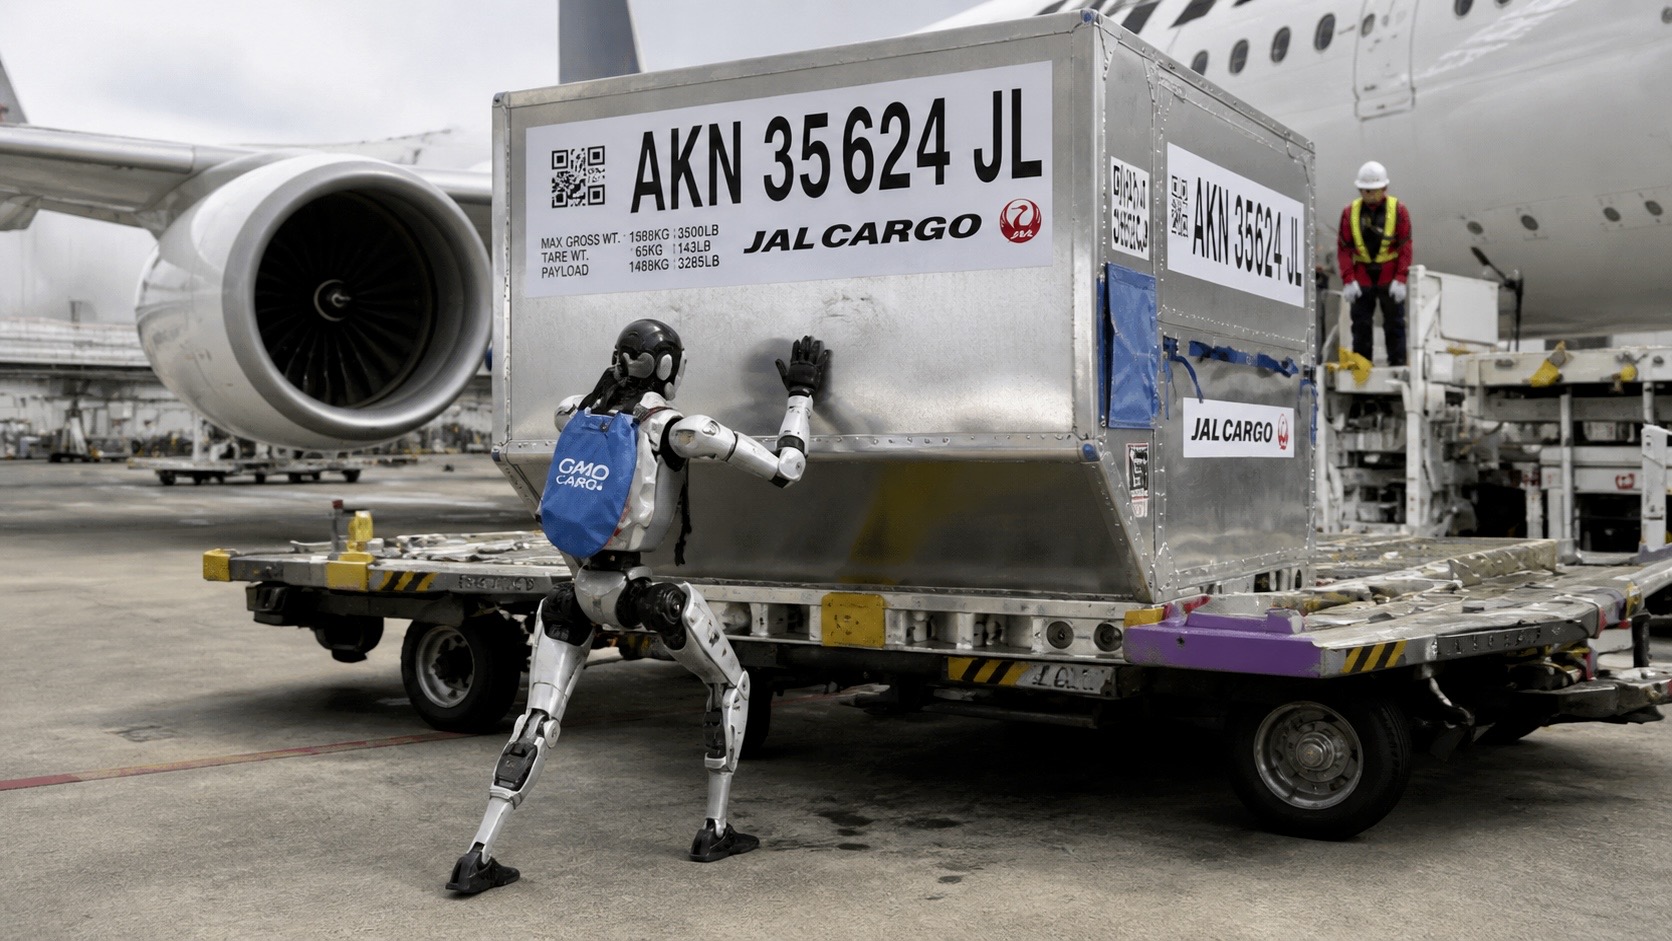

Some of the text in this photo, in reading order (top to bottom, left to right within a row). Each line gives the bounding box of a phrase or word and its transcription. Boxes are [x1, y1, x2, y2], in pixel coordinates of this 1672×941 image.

[630, 87, 1043, 214] AKN 35624 JL
[541, 224, 719, 249] MAX GROSS WT. 1588KG 3500LB
[743, 213, 983, 254] JAL CARGO
[1192, 177, 1302, 287] AKN 35624 JL
[541, 239, 711, 264] TARE WT. 65KG 143LB
[541, 255, 720, 279] PAYLOAD 1488KG 3285LB
[1191, 417, 1273, 443] JAL CARGO
[558, 457, 610, 481] GMO
